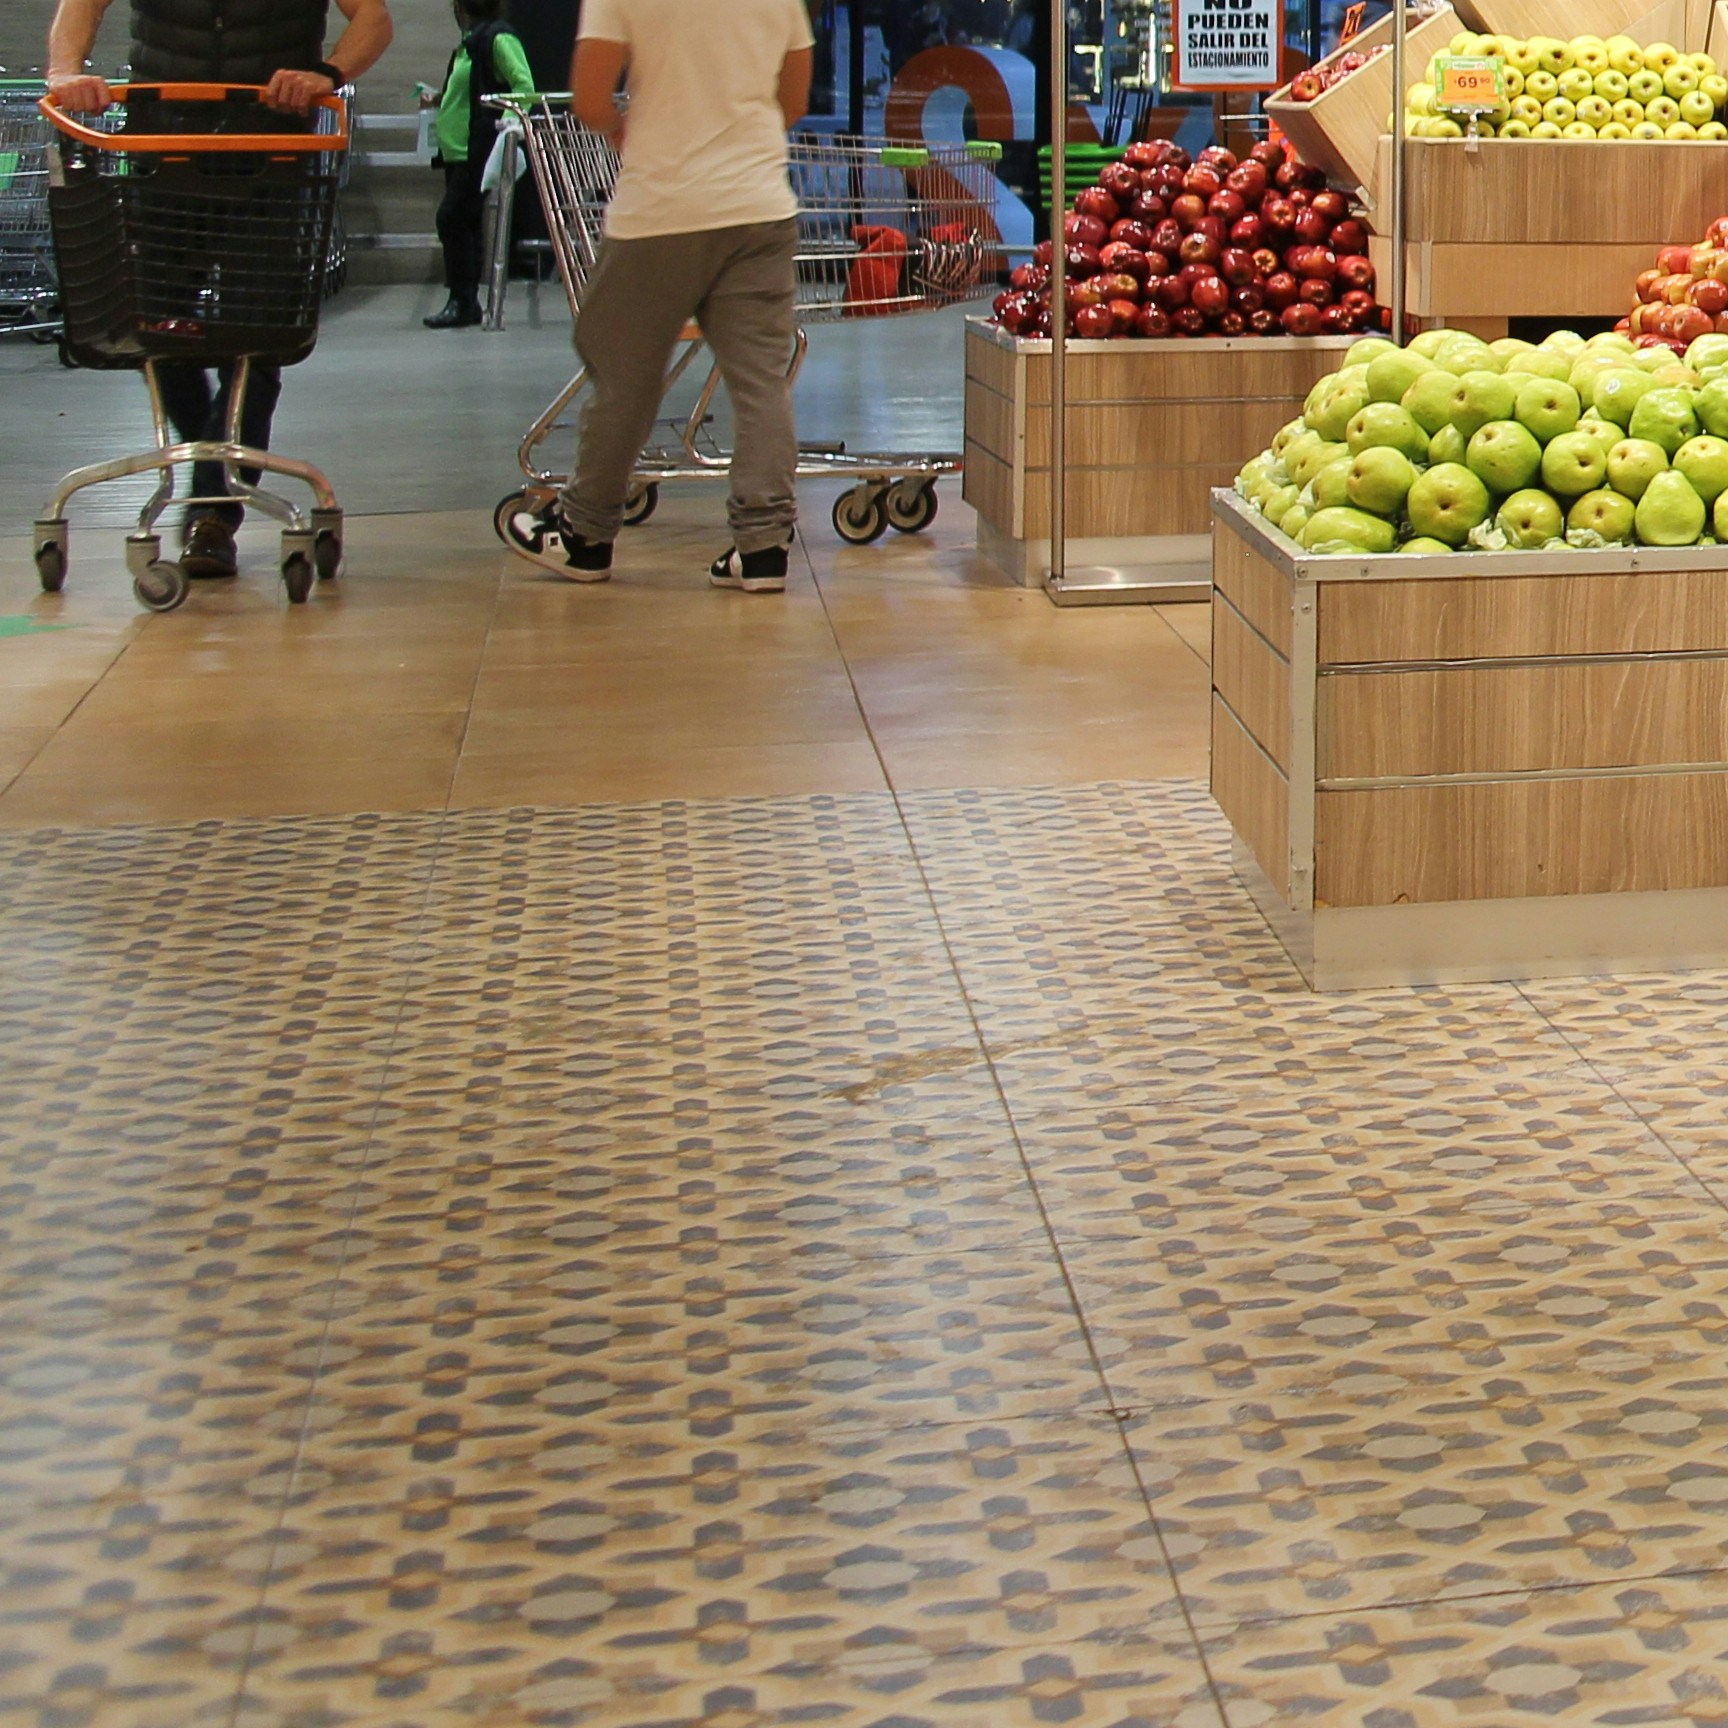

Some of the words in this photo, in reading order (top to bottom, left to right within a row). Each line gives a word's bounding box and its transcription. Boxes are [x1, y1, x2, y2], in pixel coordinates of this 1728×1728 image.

[1188, 13, 1269, 29] PUEDEN
[1188, 32, 1235, 49] SALIR
[1239, 32, 1268, 49] DEL
[1188, 51, 1269, 69] ESTACIONAMIENTO
